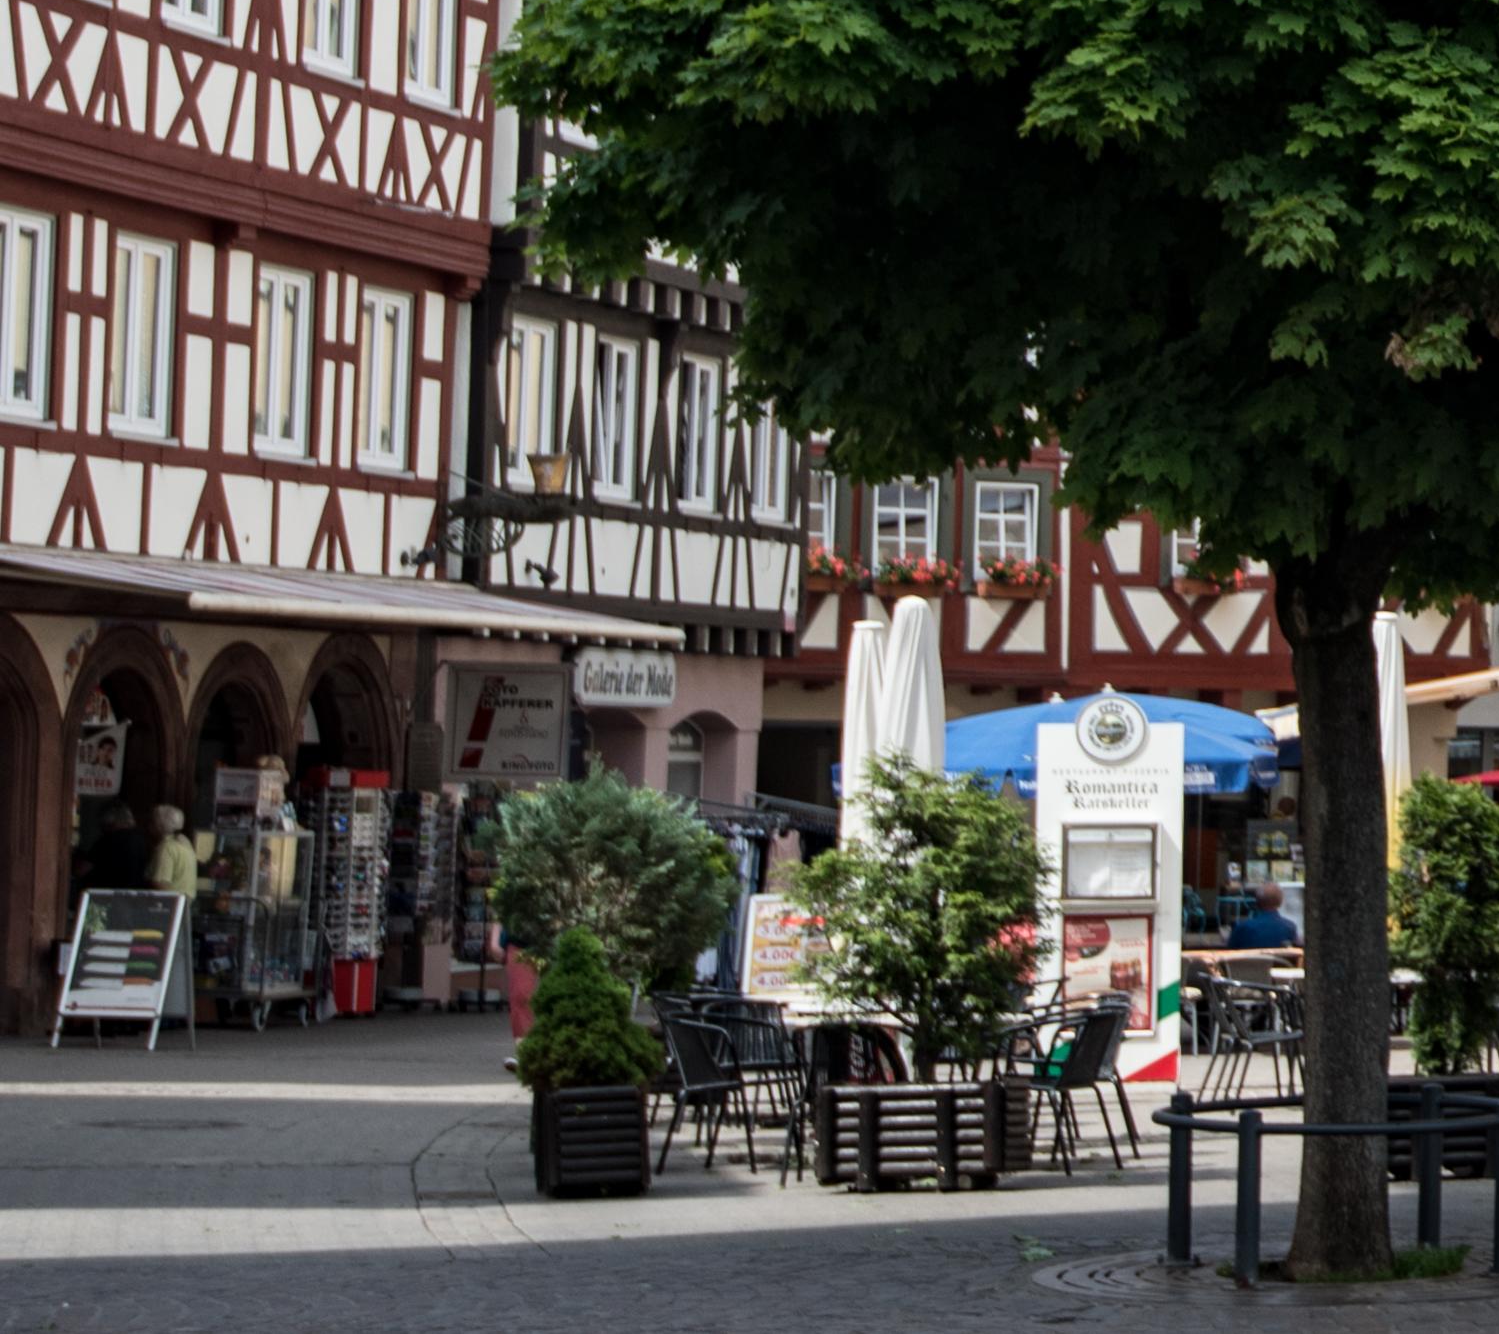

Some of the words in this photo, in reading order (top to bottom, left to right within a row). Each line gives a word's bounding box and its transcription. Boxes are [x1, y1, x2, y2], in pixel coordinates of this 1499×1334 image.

[584, 660, 624, 695] Galerie
[625, 663, 644, 697] der
[1064, 779, 1159, 796] Romantica
